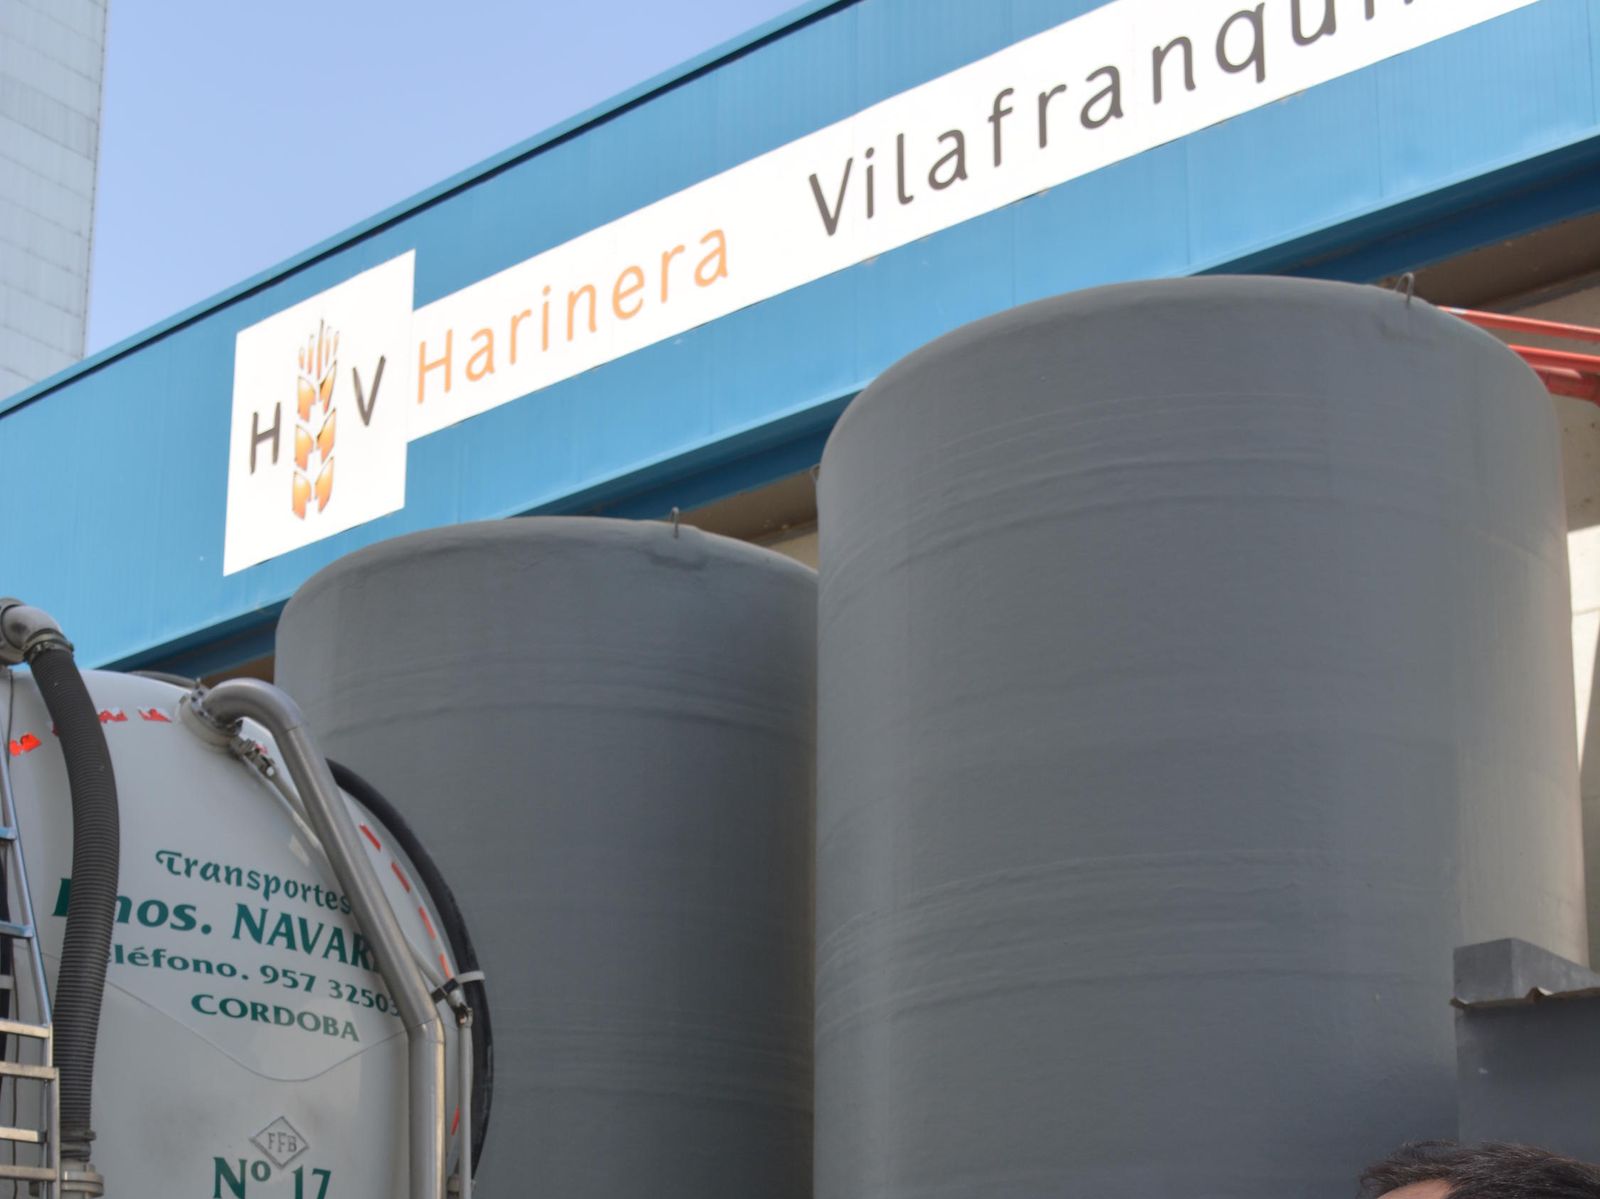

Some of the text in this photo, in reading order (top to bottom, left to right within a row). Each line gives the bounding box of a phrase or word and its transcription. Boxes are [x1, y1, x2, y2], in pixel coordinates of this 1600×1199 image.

[416, 0, 1413, 404] Harinera Vilafranqu
[251, 355, 386, 475] H V
[155, 850, 352, 914] Transportes
[260, 965, 316, 993] 957
[191, 994, 360, 1042] CORDOBA
[267, 1131, 297, 1153] FFB
